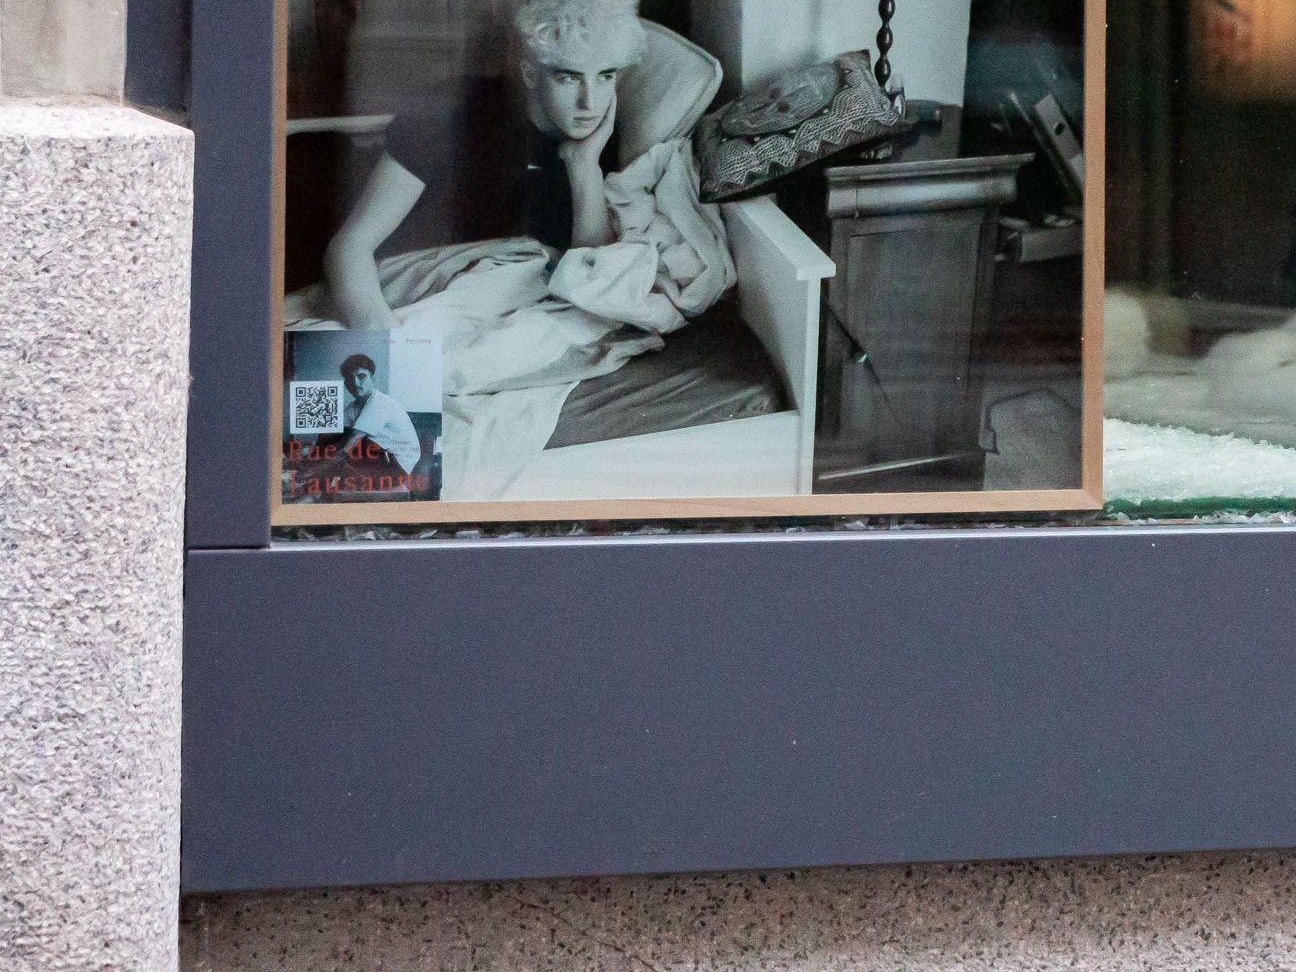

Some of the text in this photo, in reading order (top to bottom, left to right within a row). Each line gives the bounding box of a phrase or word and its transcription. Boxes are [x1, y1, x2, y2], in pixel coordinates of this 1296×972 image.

[289, 440, 337, 461] Rue
[349, 436, 381, 459] de
[289, 471, 430, 496] Lausanne
